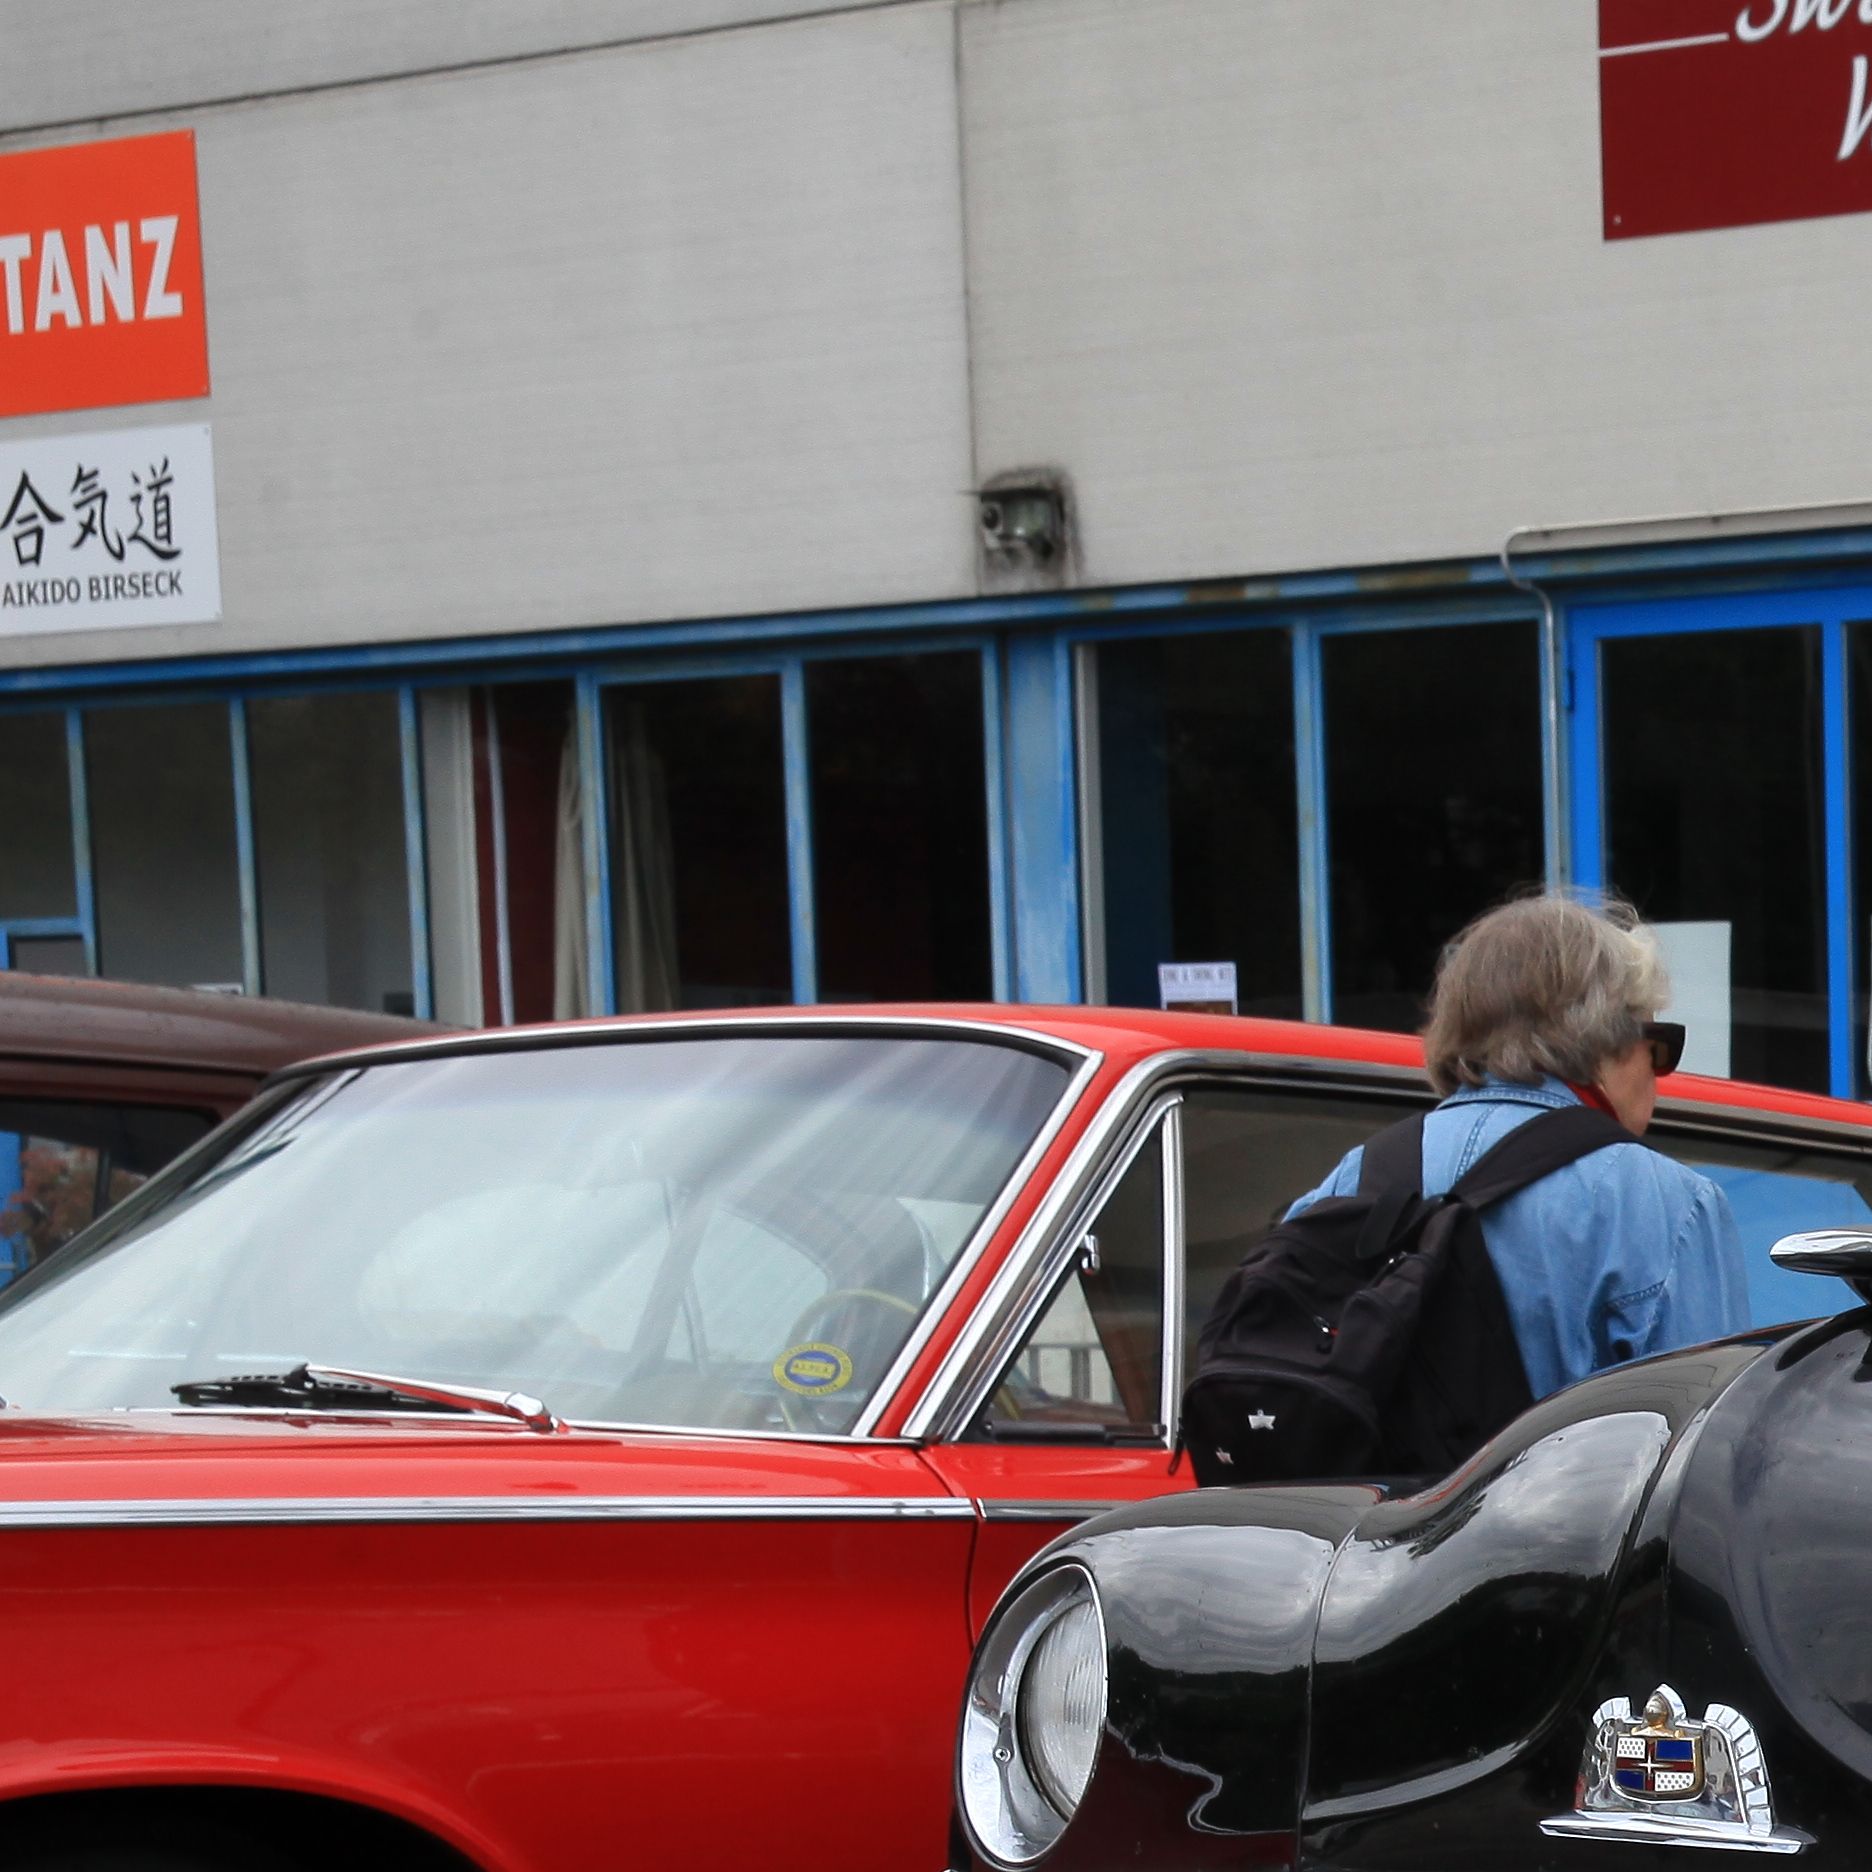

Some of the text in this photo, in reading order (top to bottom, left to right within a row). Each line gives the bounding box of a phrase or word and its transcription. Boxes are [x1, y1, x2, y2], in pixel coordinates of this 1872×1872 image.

[0, 215, 183, 335] TANZ
[0, 456, 183, 567] 合気道
[3, 570, 183, 609] AIKIDO BIRSECK
